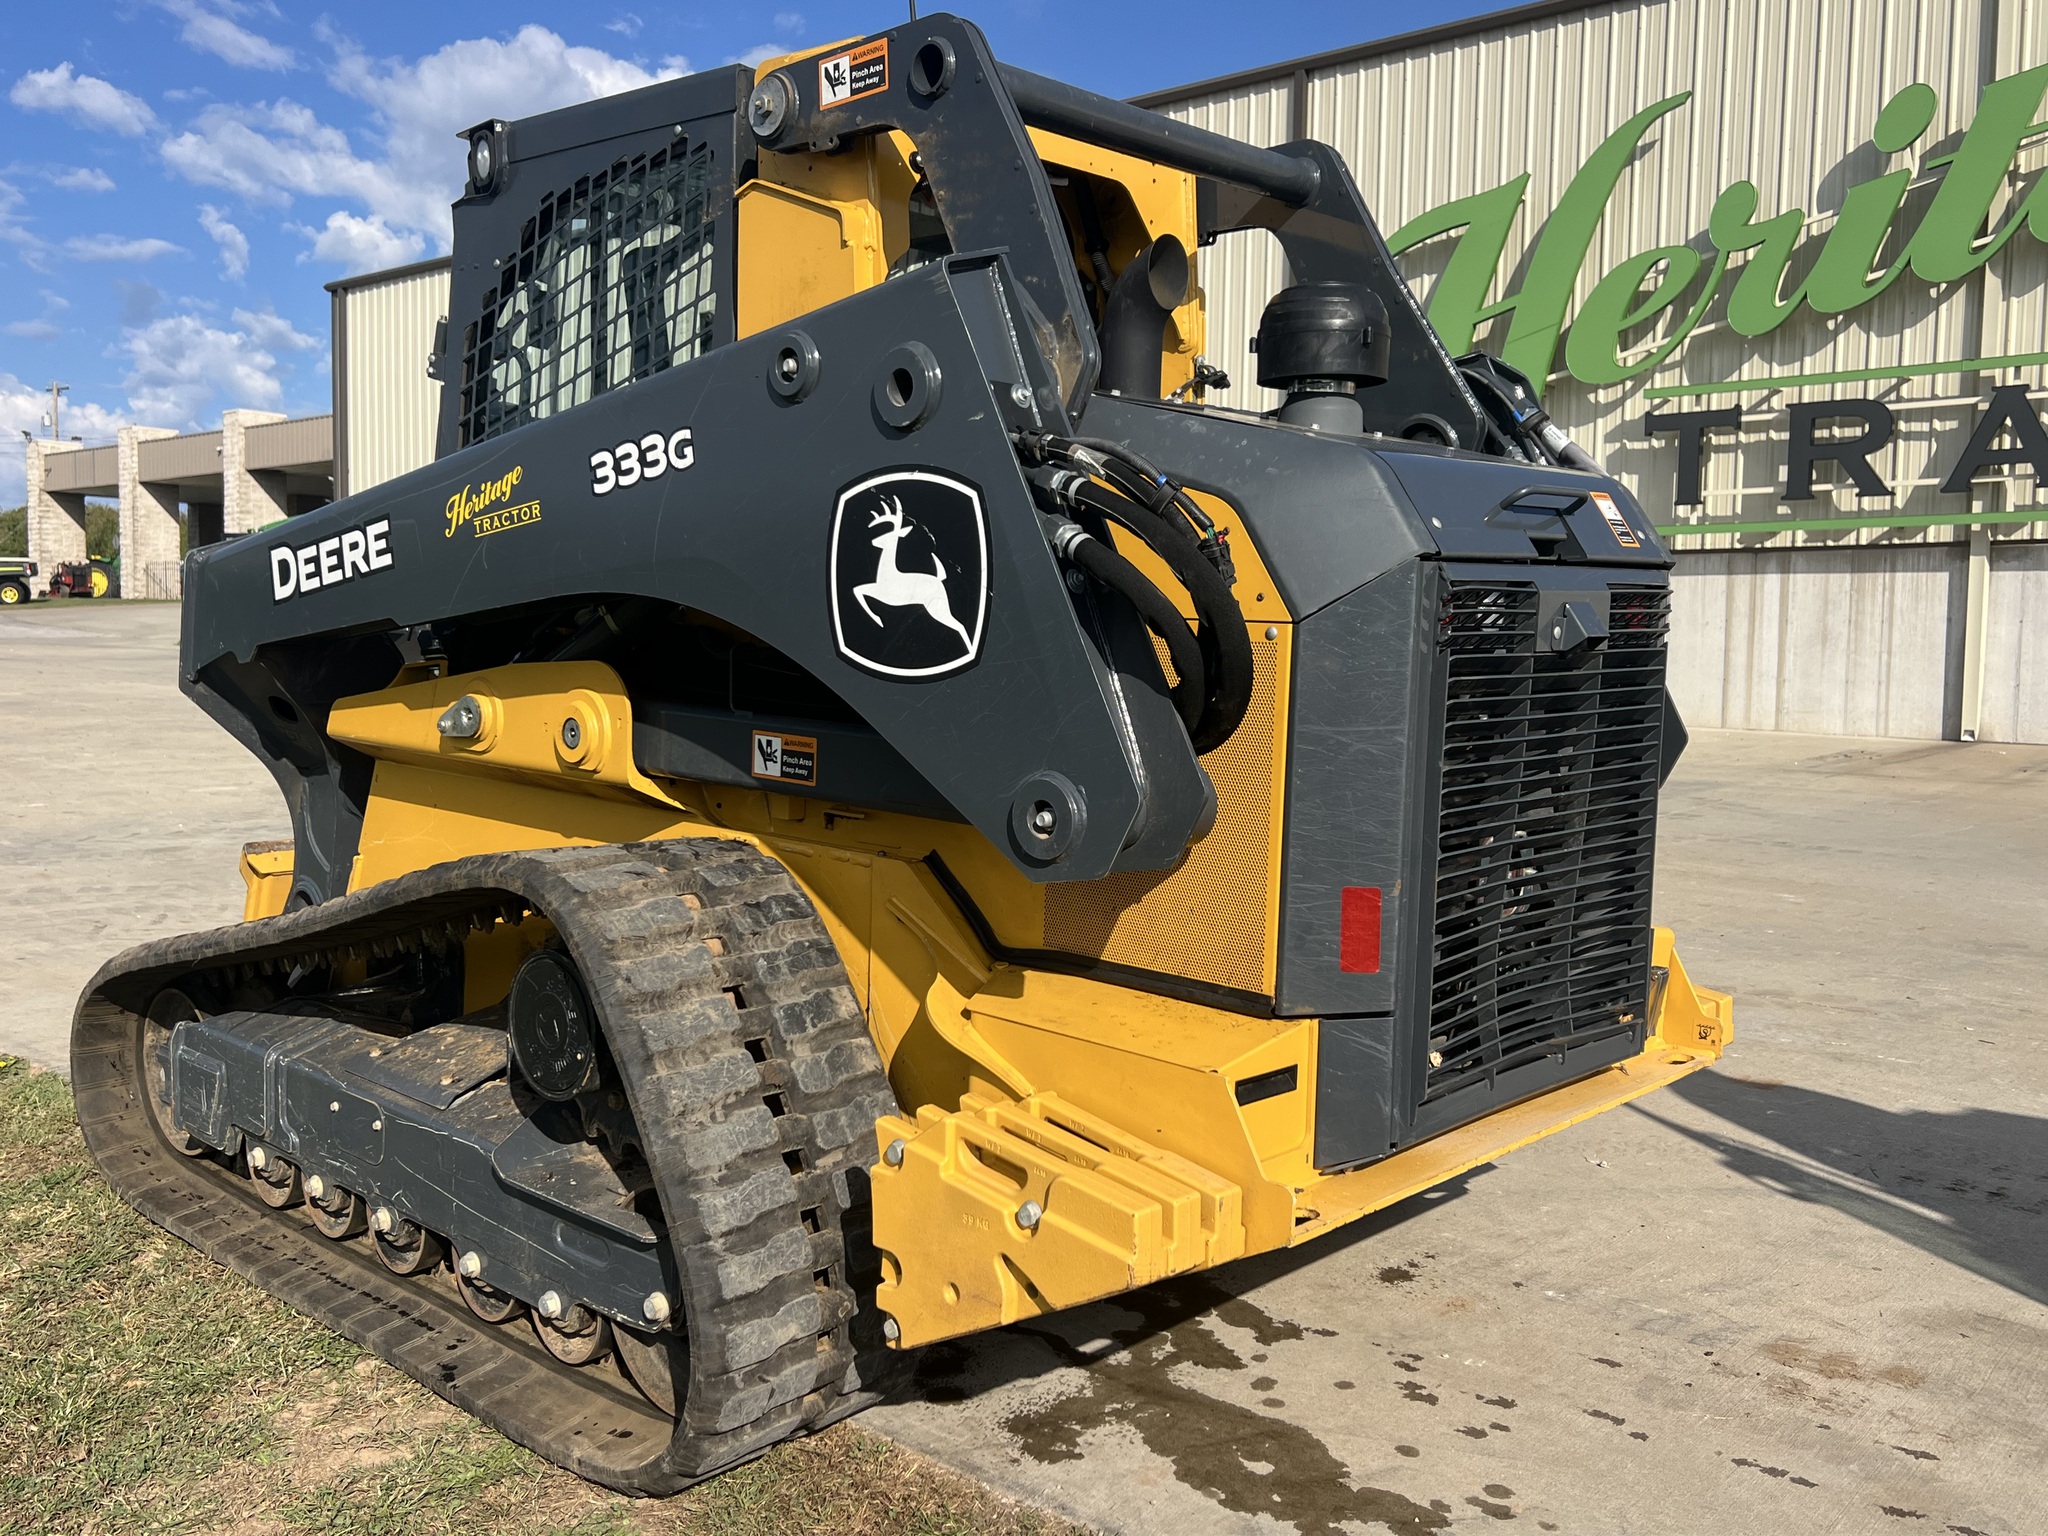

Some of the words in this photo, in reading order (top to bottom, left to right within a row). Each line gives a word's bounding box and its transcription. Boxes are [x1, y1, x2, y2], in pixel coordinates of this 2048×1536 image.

[857, 44, 884, 58] WARNING
[852, 68, 869, 79] Pinch
[869, 63, 884, 74] Area
[852, 81, 865, 90] Keep
[866, 75, 880, 85] Away
[1384, 62, 2048, 399] Herit
[1644, 384, 2048, 506] TRA
[590, 428, 695, 494] 333G
[445, 465, 524, 538] Heritage
[473, 503, 541, 534] TRACTOR
[270, 519, 393, 601] DEERE
[789, 740, 814, 749] WARNING
[782, 755, 799, 765] Pinch
[799, 757, 813, 767] Area
[782, 765, 795, 774] Keep
[795, 767, 808, 777] Away
